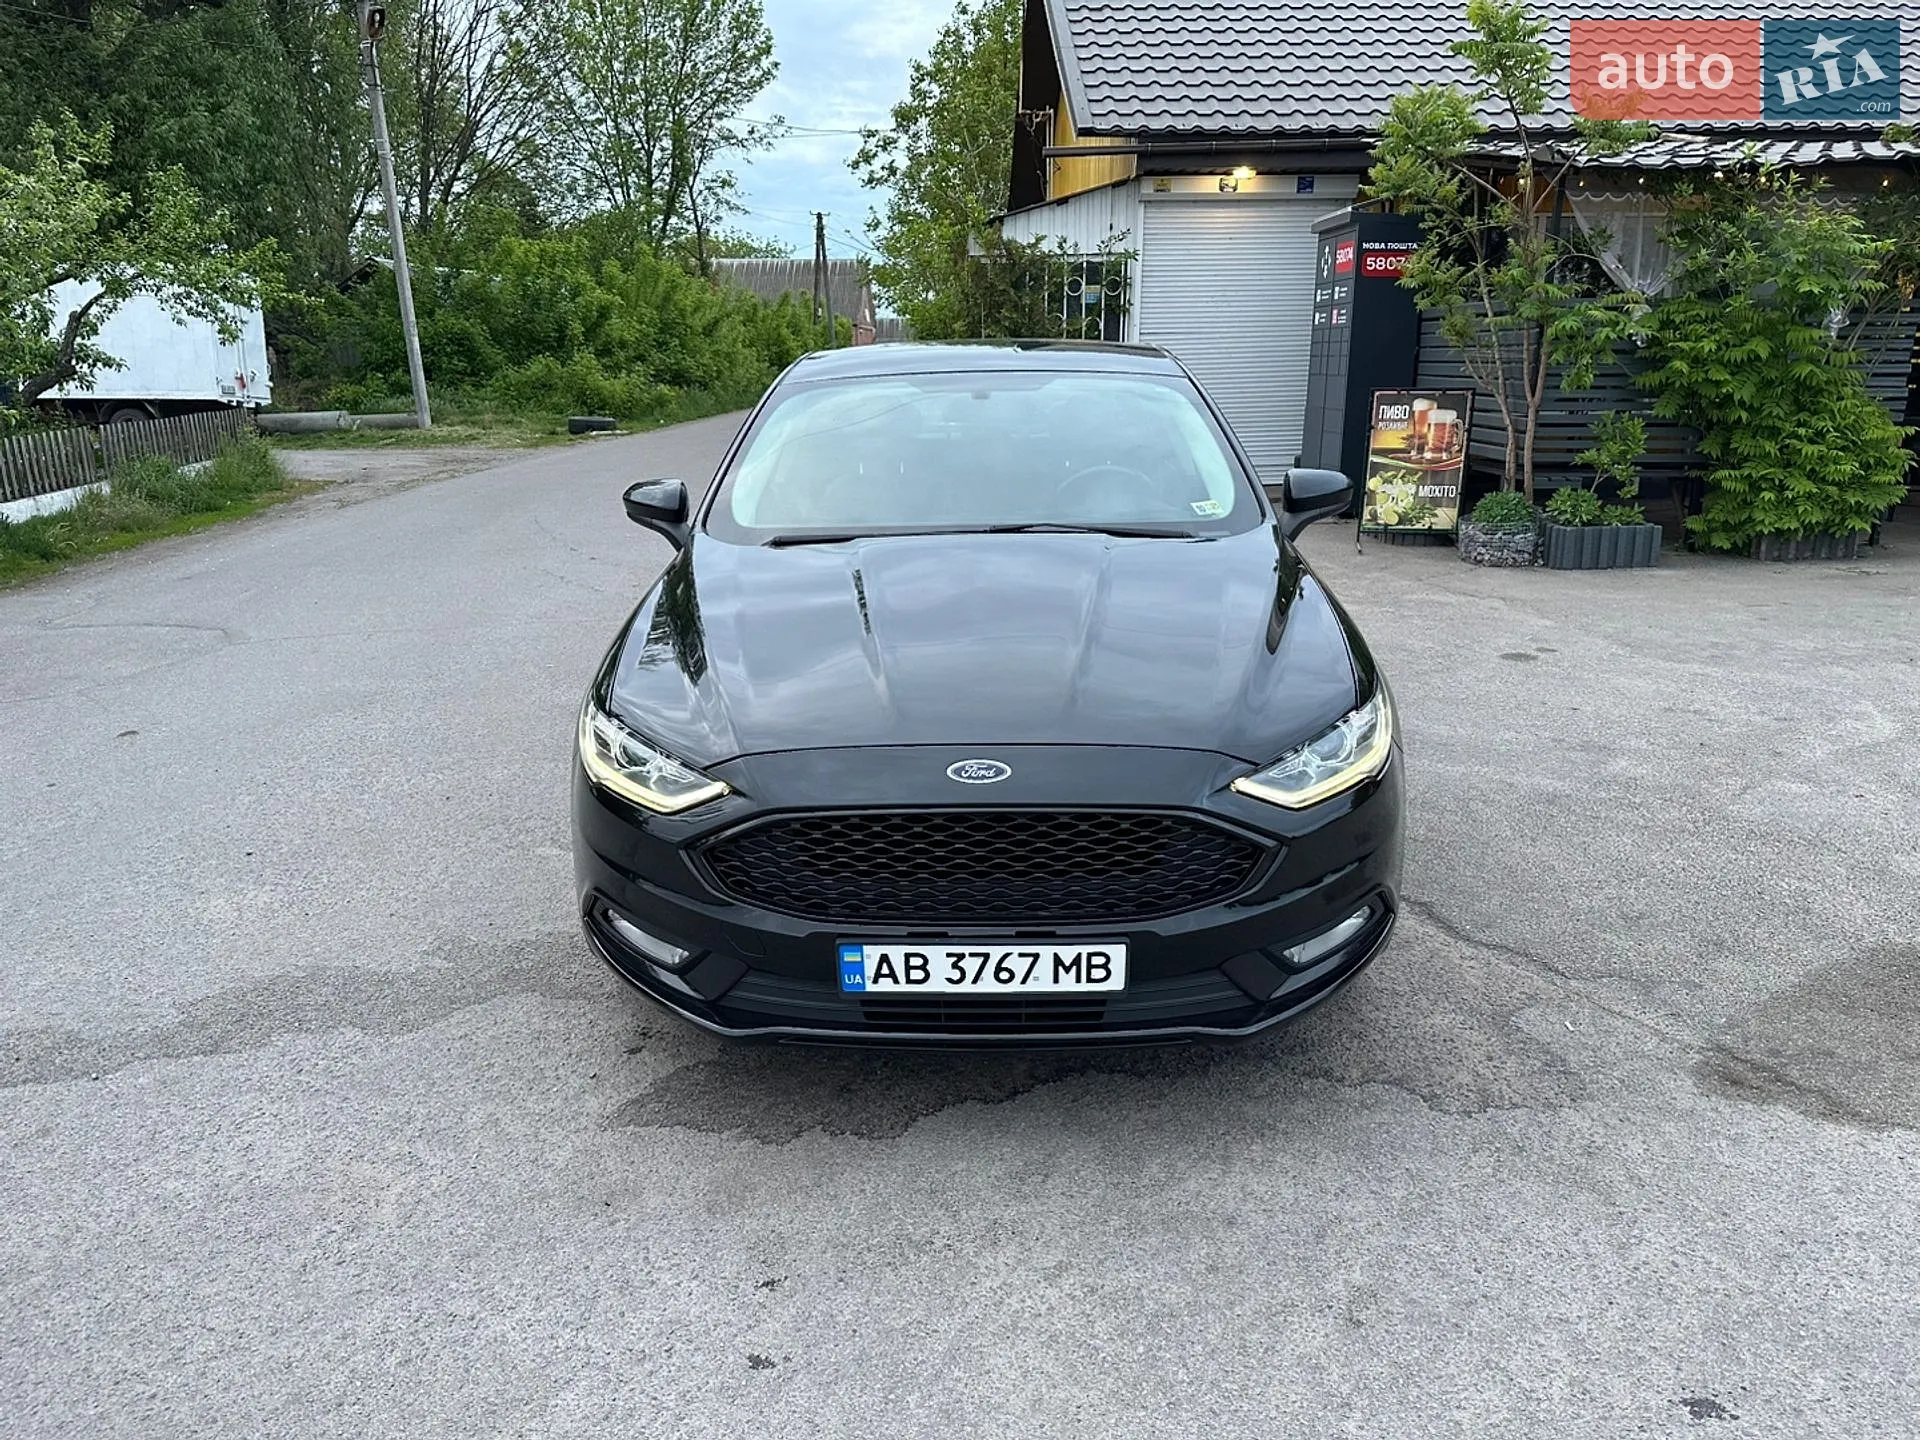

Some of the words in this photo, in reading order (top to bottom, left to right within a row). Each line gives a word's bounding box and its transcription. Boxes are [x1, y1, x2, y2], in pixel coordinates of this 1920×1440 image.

[1366, 257, 1406, 270] 5807
[1378, 405, 1410, 419] ПИВО
[961, 764, 996, 778] Ford
[871, 952, 931, 985] AB
[944, 952, 1041, 985] 3767
[1052, 951, 1112, 983] MB
[845, 975, 863, 985] UA
